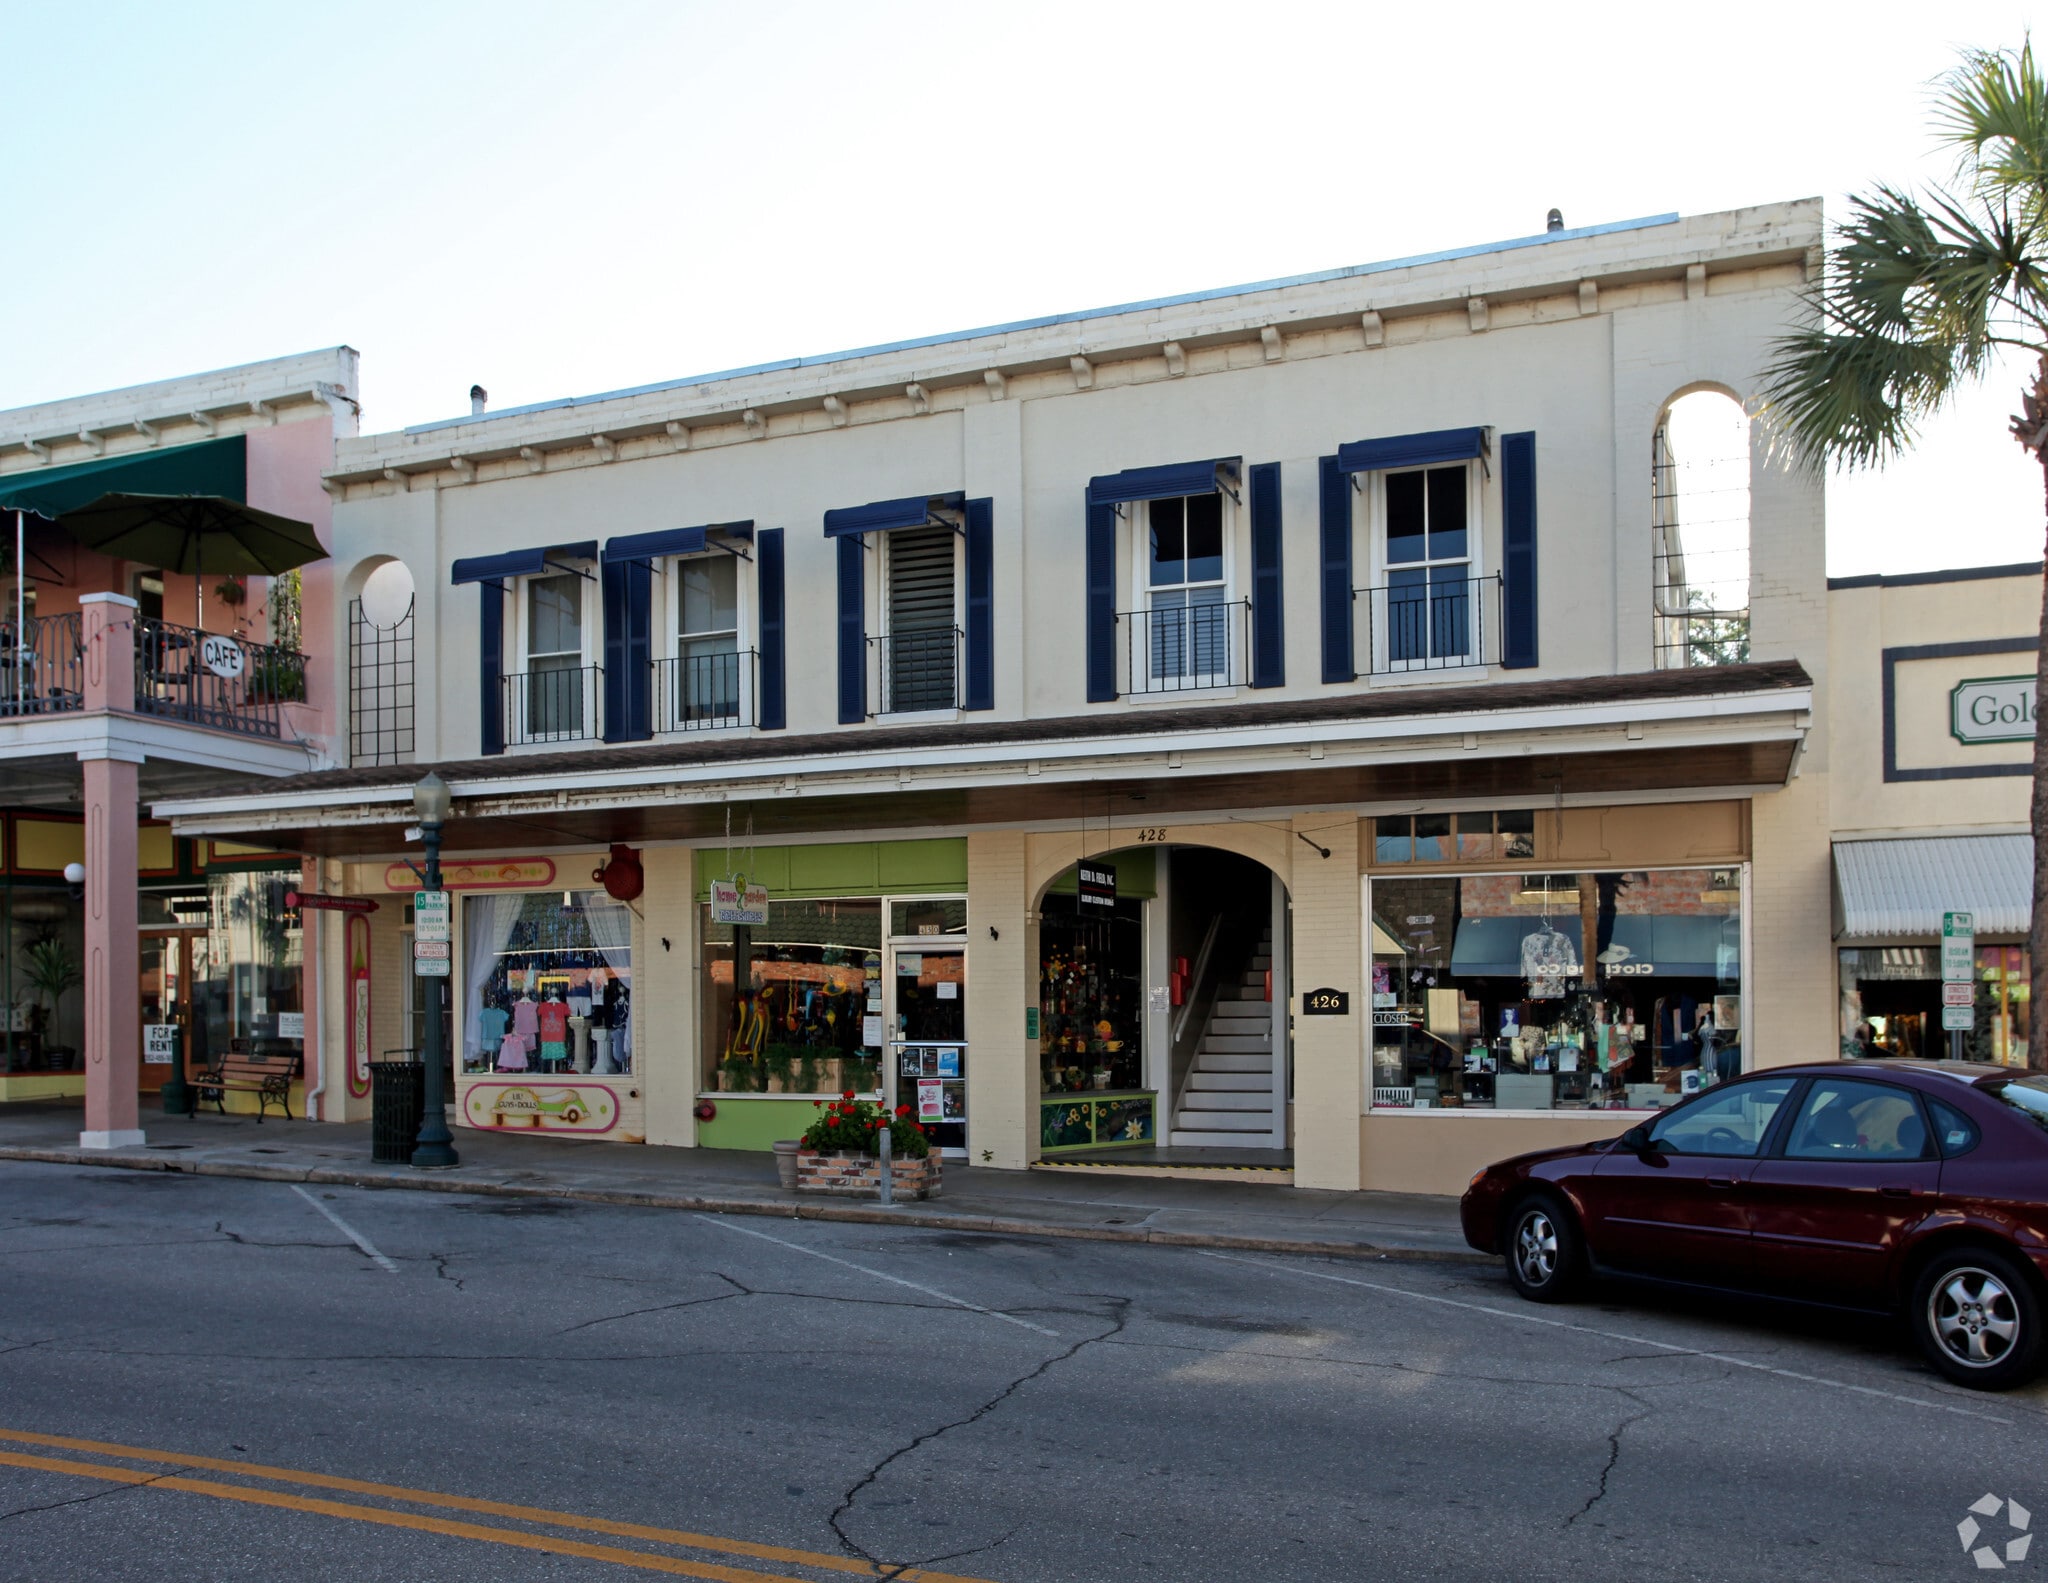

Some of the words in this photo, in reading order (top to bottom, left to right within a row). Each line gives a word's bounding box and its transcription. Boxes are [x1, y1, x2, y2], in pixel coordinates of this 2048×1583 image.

[1138, 828, 1167, 842] 428
[417, 896, 425, 906] 15
[1311, 995, 1340, 1008] 426
[358, 986, 367, 1053] CLOSED
[1373, 1013, 1408, 1024] CLOSED
[152, 1027, 169, 1039] FOR
[150, 1040, 172, 1051] RENT
